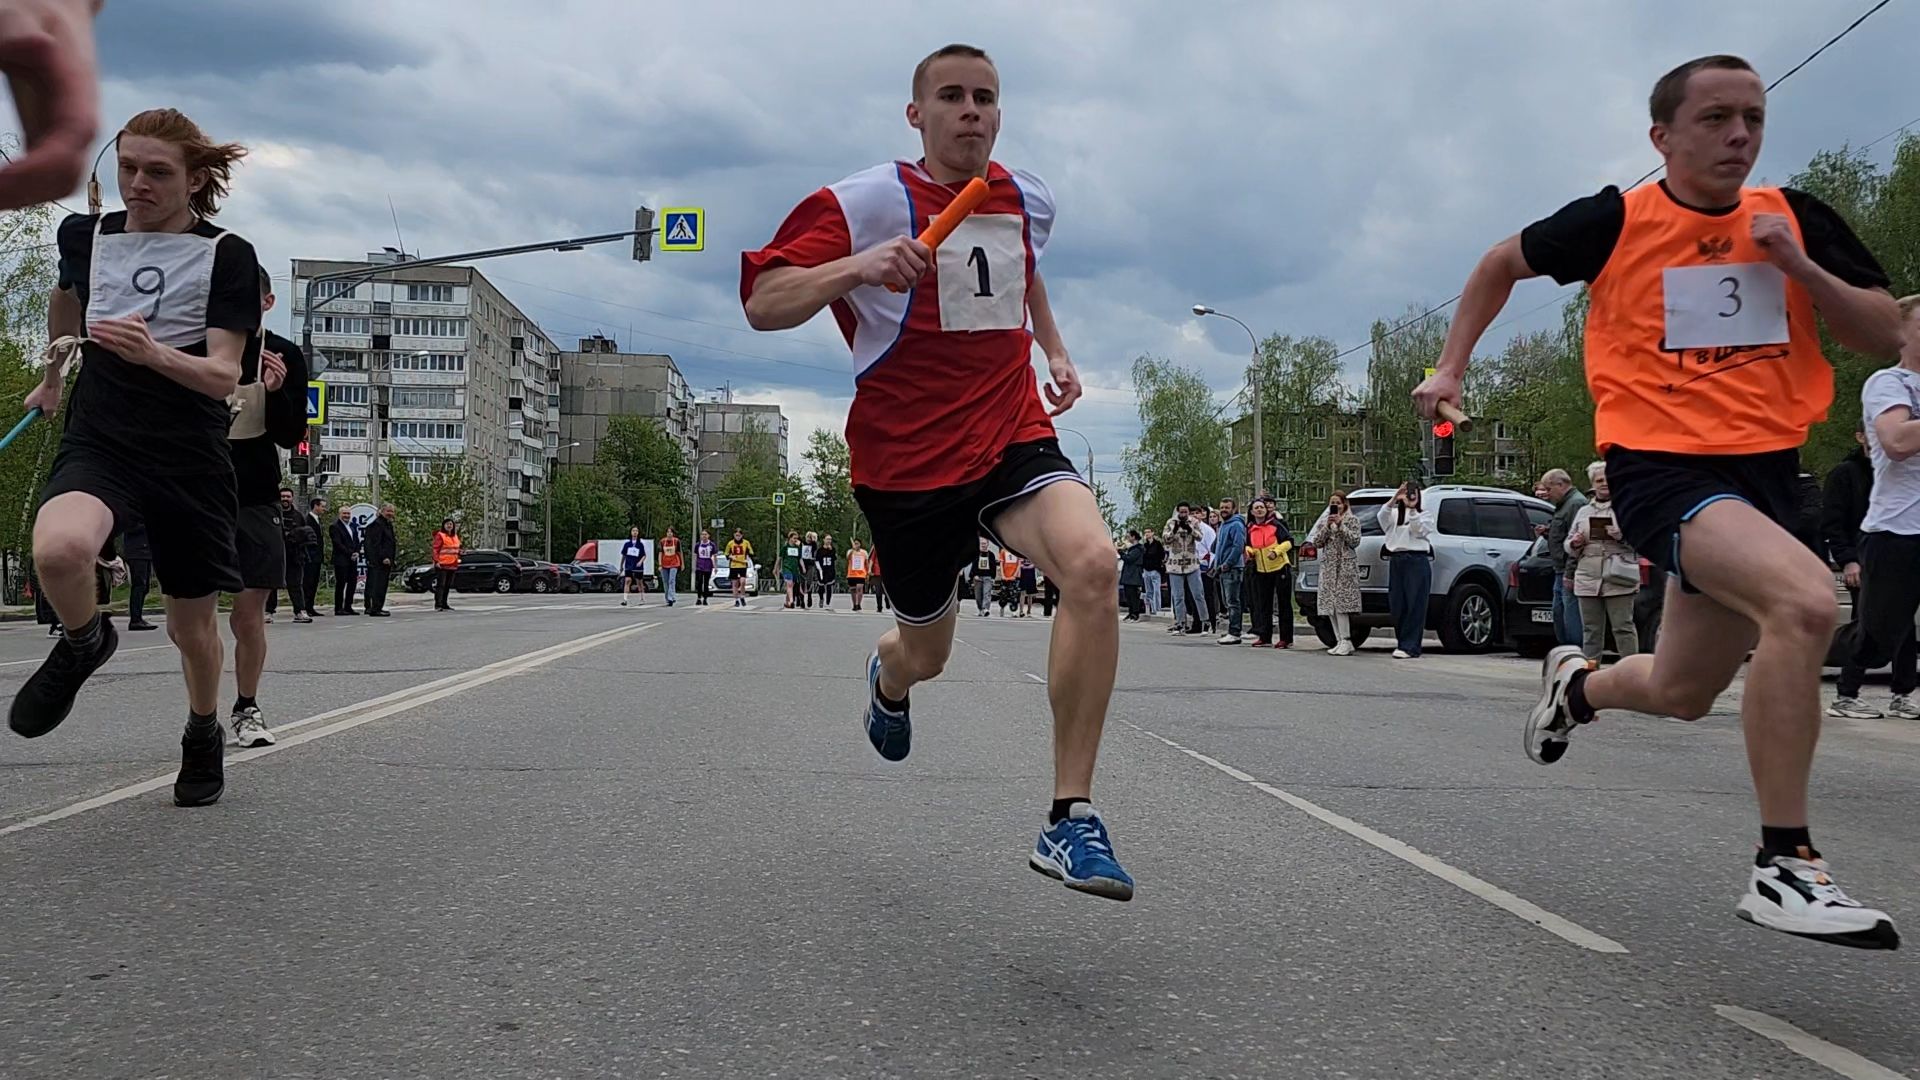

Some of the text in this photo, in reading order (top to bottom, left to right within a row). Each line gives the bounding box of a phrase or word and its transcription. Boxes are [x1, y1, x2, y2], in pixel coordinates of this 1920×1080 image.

[132, 266, 165, 322] 9
[967, 246, 994, 297] 1
[1718, 277, 1742, 318] 3
[822, 557, 832, 566] 15
